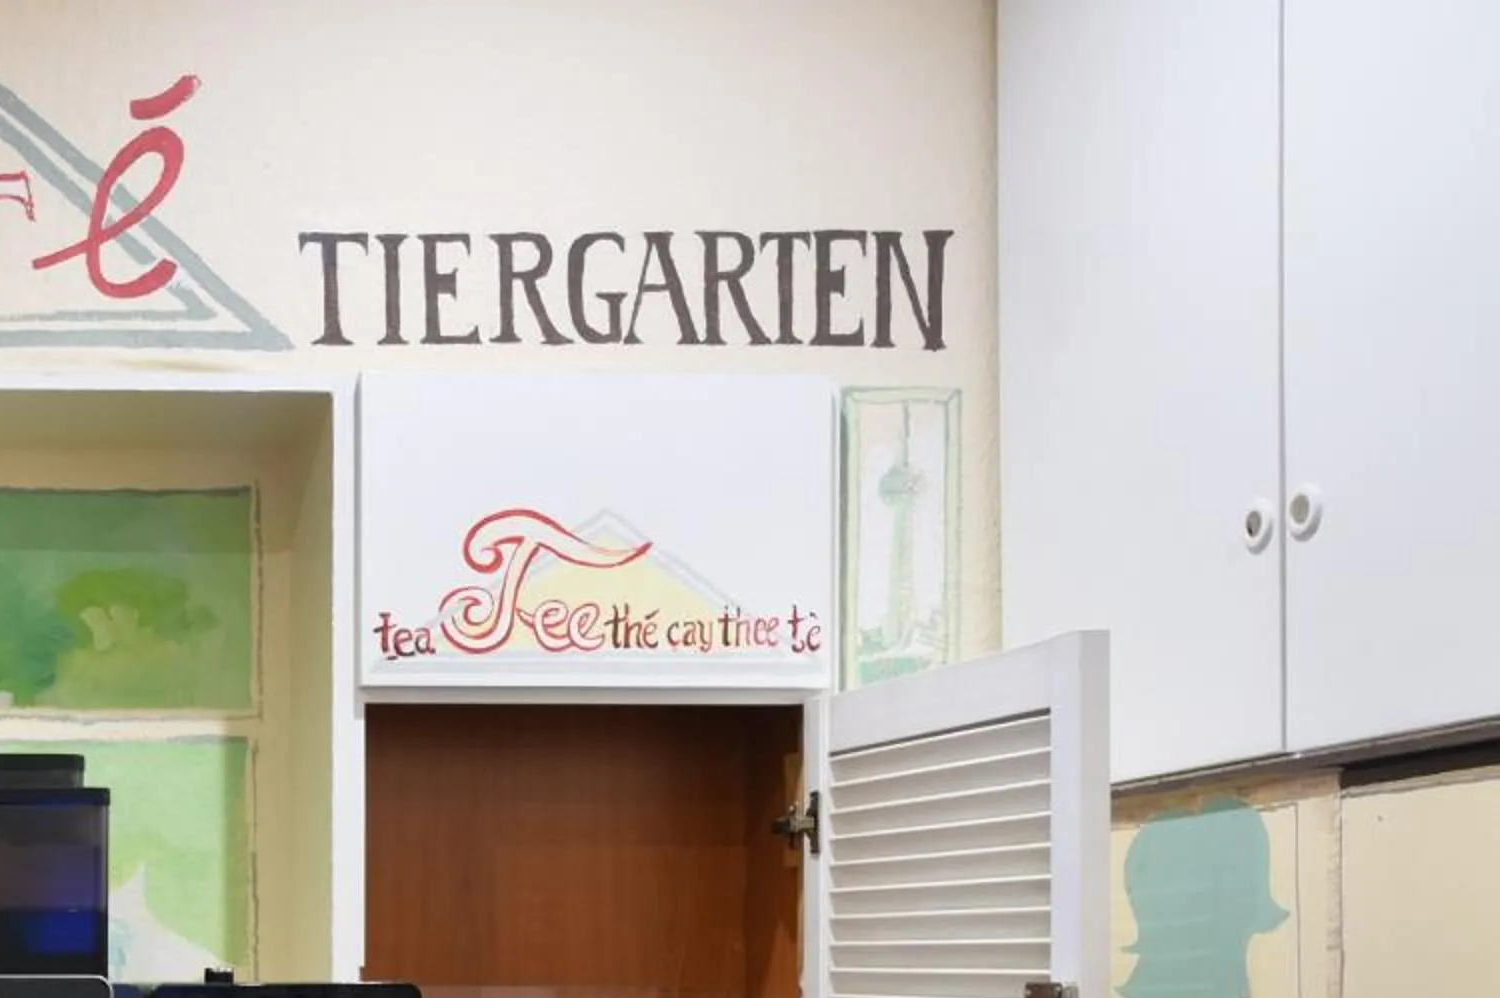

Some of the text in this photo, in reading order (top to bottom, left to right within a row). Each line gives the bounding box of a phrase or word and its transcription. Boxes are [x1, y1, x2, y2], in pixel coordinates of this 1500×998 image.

[298, 229, 954, 349] TIERGARTEN
[373, 611, 436, 661] tea
[604, 602, 660, 650] thé
[666, 618, 714, 654] cay
[717, 605, 781, 648] thee
